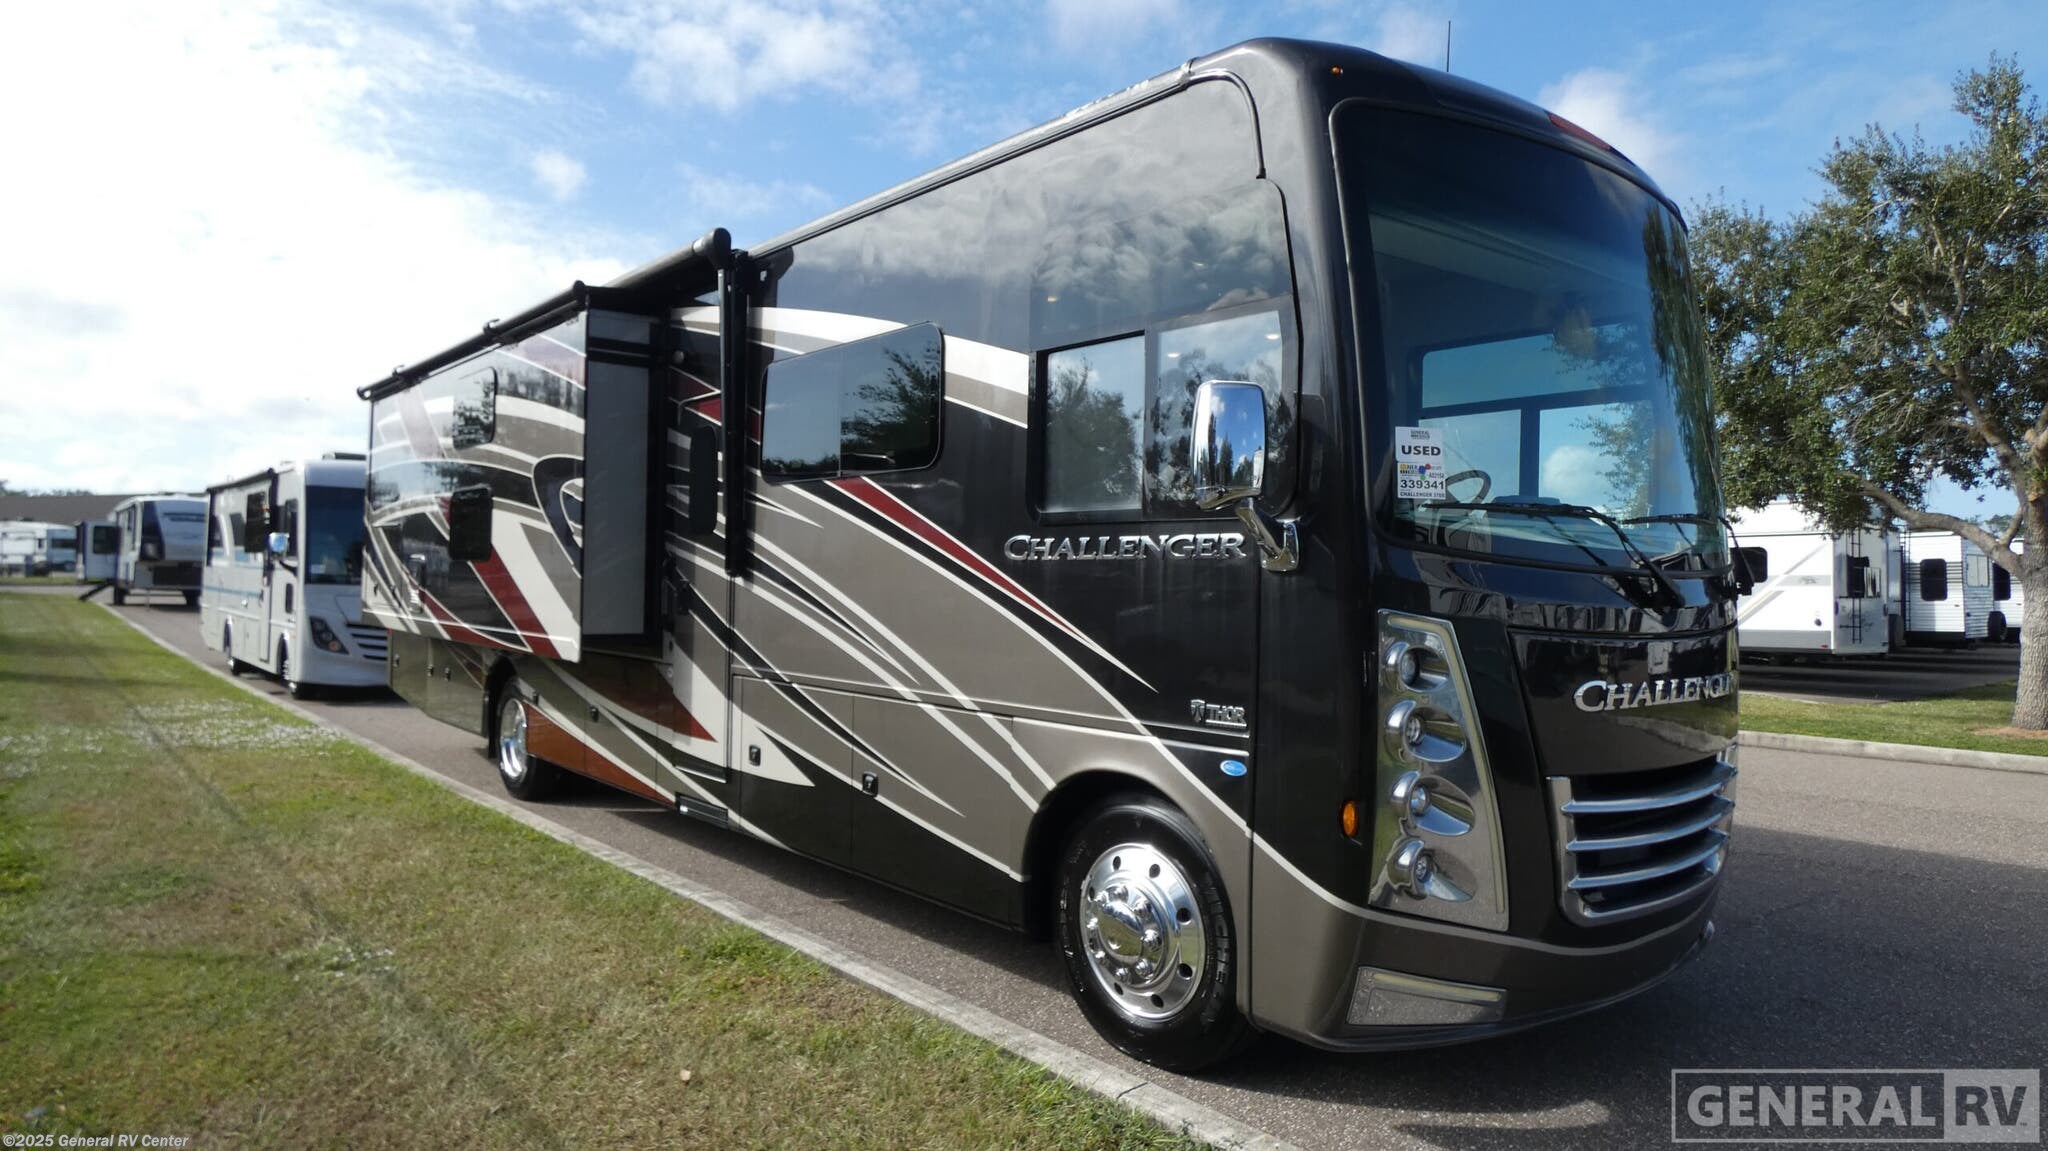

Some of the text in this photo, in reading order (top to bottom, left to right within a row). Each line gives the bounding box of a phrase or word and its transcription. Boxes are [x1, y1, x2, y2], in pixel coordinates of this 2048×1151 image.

[1401, 445, 1441, 456] USED
[1400, 479, 1444, 490] 339341
[1004, 532, 1246, 561] CHALLENGER
[1206, 704, 1246, 724] THOR
